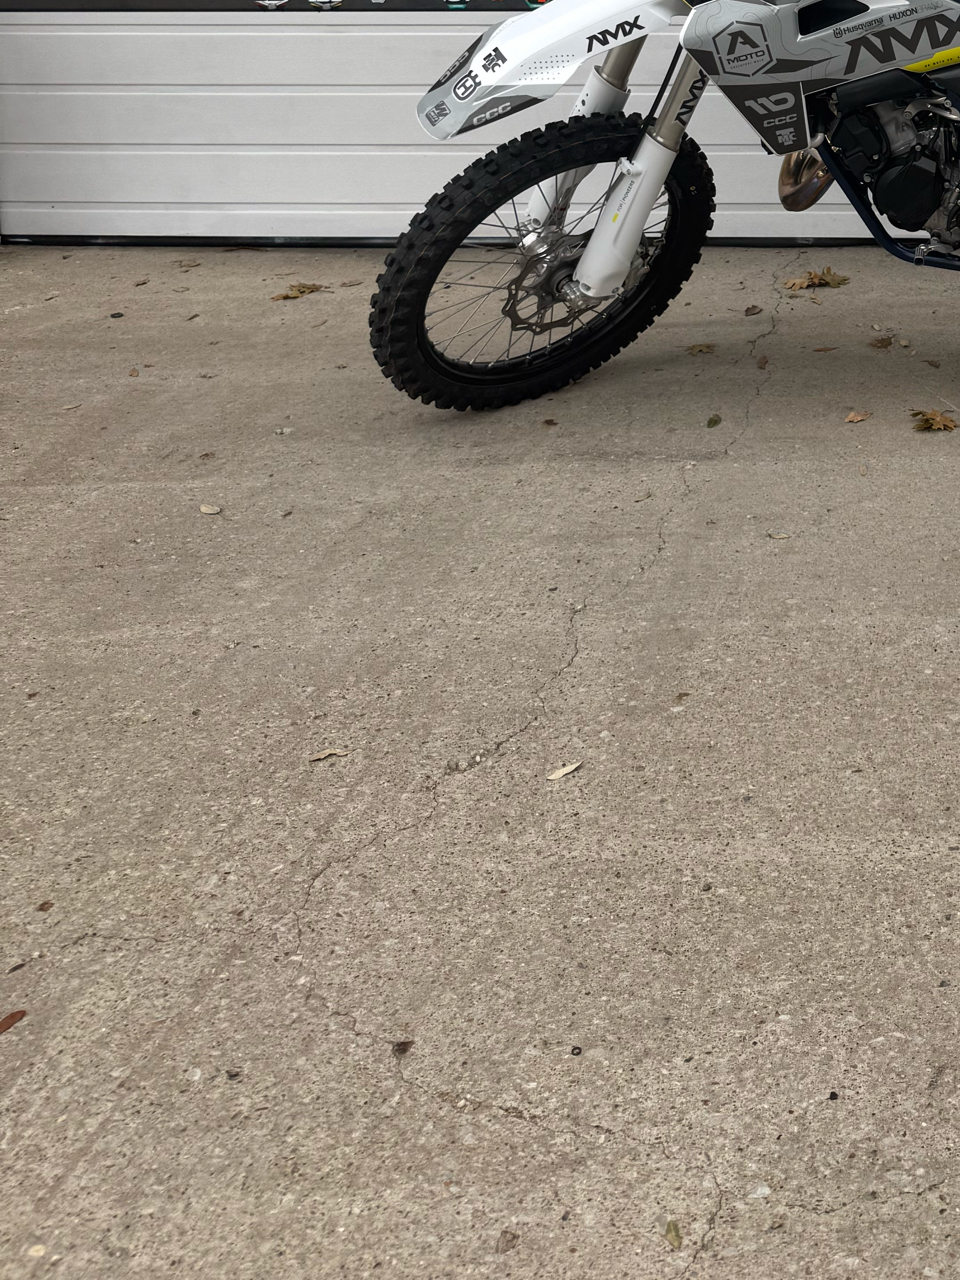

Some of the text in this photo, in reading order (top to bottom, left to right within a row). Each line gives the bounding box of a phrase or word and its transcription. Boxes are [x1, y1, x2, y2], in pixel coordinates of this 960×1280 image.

[586, 14, 646, 53] AMX
[843, 16, 885, 36] Husqvarna
[726, 50, 766, 65] MOTO
[472, 102, 512, 126] CCC
[763, 113, 798, 128] CCC
